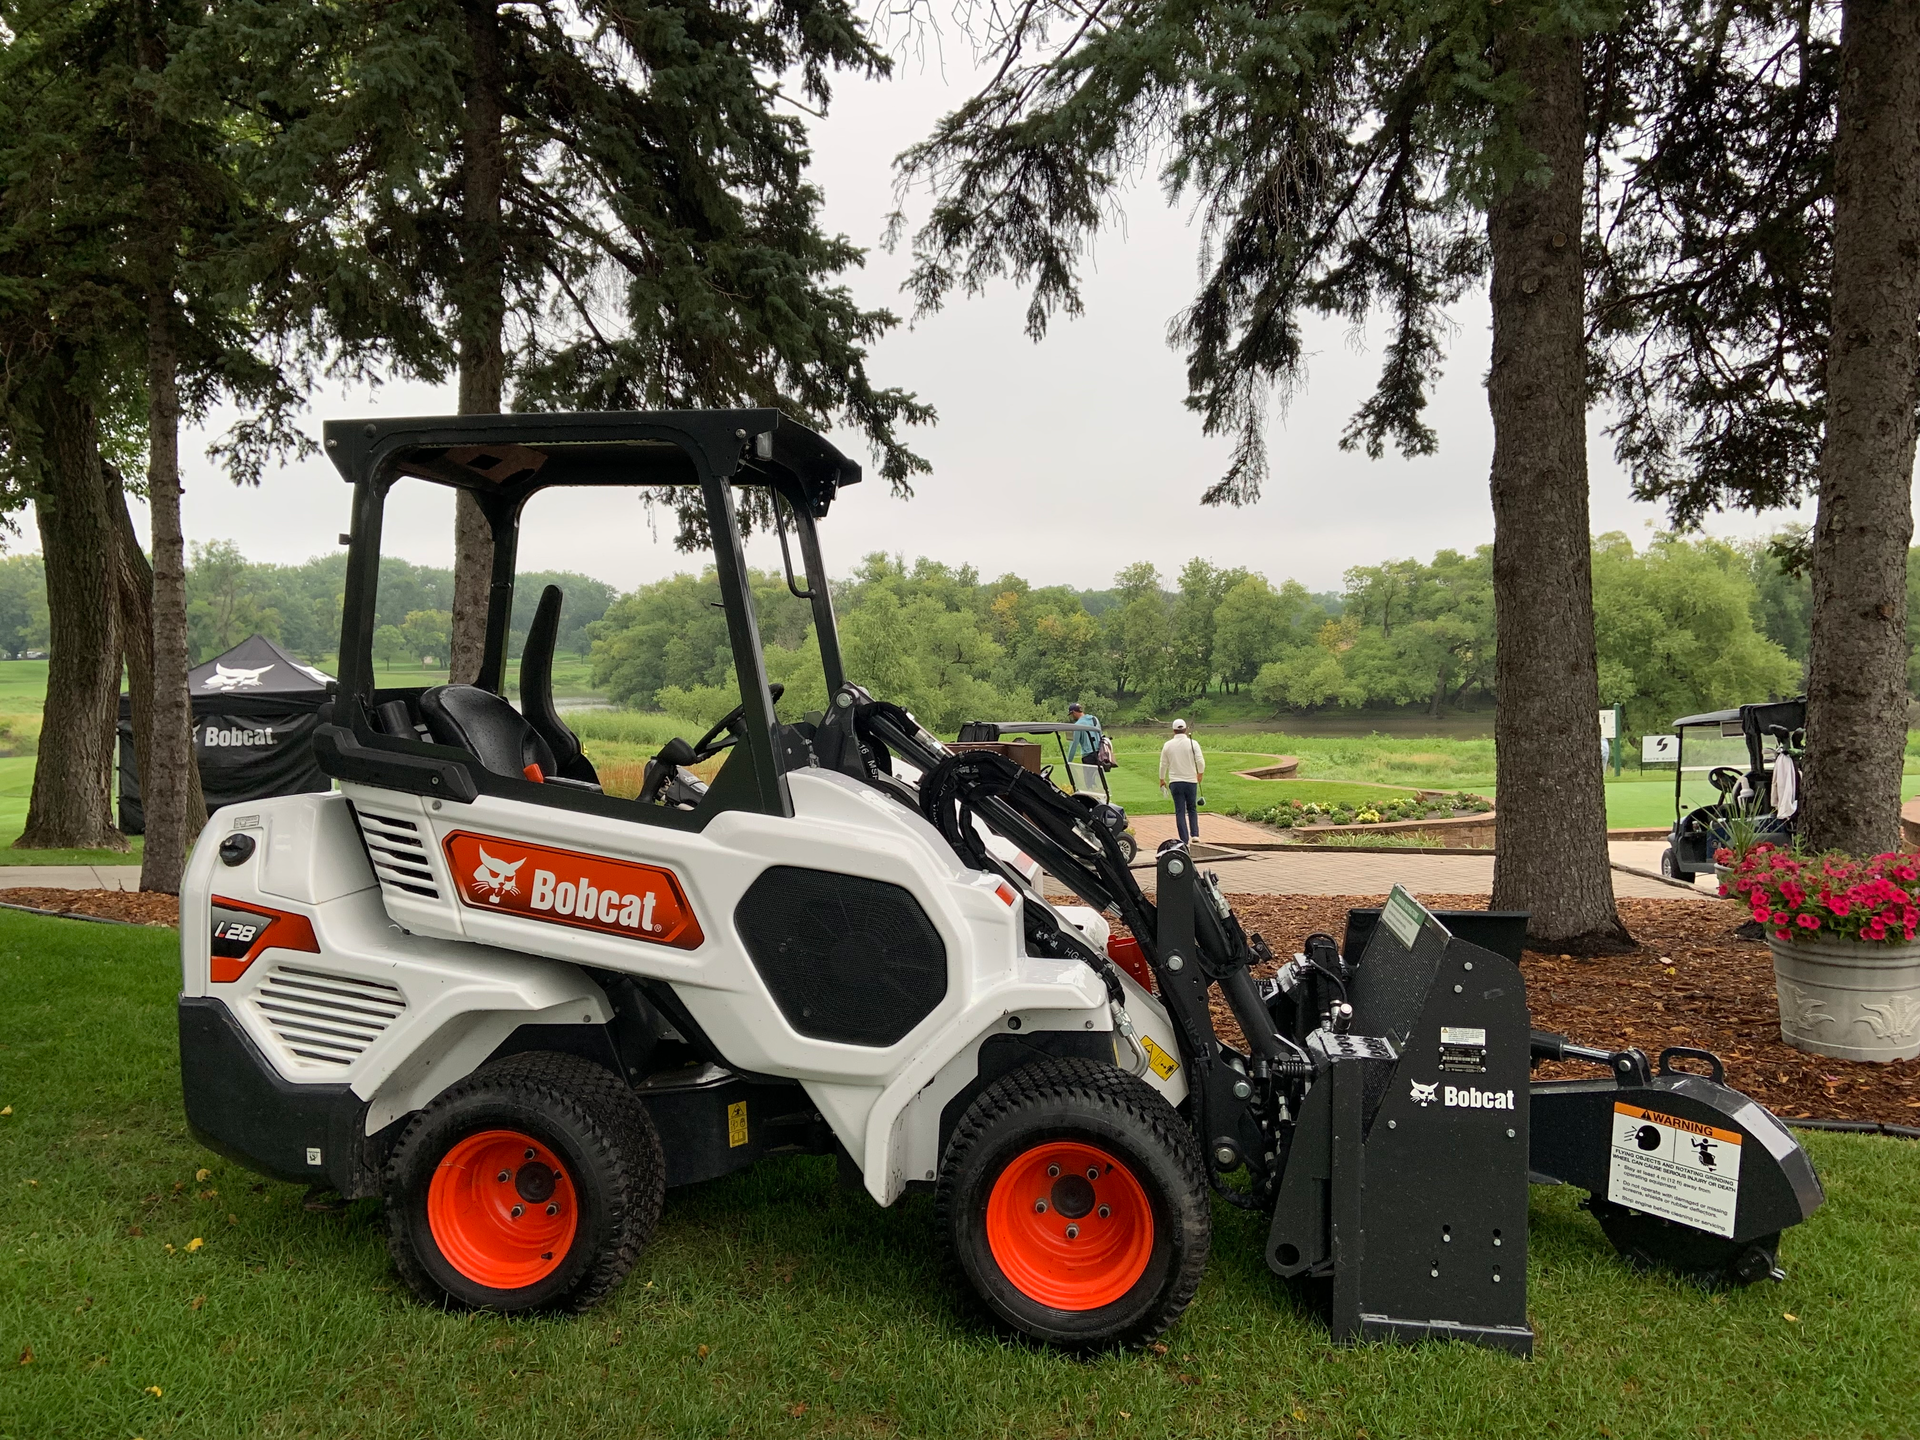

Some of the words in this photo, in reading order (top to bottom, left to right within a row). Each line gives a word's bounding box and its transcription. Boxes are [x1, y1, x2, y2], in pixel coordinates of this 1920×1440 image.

[204, 726, 273, 746] Bobcat
[530, 868, 656, 932] Bobcat
[214, 922, 257, 942] L28
[1444, 1086, 1514, 1110] Bobcat
[1652, 1112, 1712, 1136] WARNING
[1612, 1153, 1630, 1162] WHEEL
[1644, 1162, 1661, 1171] CAUSE
[1663, 1168, 1686, 1178] SERIOUS
[1688, 1175, 1706, 1184] INJURY
[1717, 1184, 1735, 1192] DEATH
[1615, 1148, 1634, 1157] FLYING
[1635, 1154, 1660, 1165] OBJECTS
[1675, 1165, 1703, 1177] ROTATING
[1704, 1174, 1733, 1186] GRINDING
[1623, 1170, 1647, 1182] operating
[1648, 1178, 1677, 1191] equipment.
[1683, 1183, 1696, 1191] away
[1621, 1195, 1633, 1203] Stop
[1634, 1200, 1651, 1209] engine
[1653, 1205, 1669, 1214] before
[1671, 1210, 1692, 1222] cleaning
[1701, 1220, 1726, 1232] servicing.
[1622, 1186, 1643, 1196] screens,
[1644, 1192, 1662, 1202] shields
[1671, 1200, 1688, 1209] rubber
[1689, 1206, 1717, 1218] deflectors.
[1640, 1186, 1660, 1196] operate
[1674, 1195, 1698, 1208] damaged
[1706, 1205, 1727, 1216] missing
